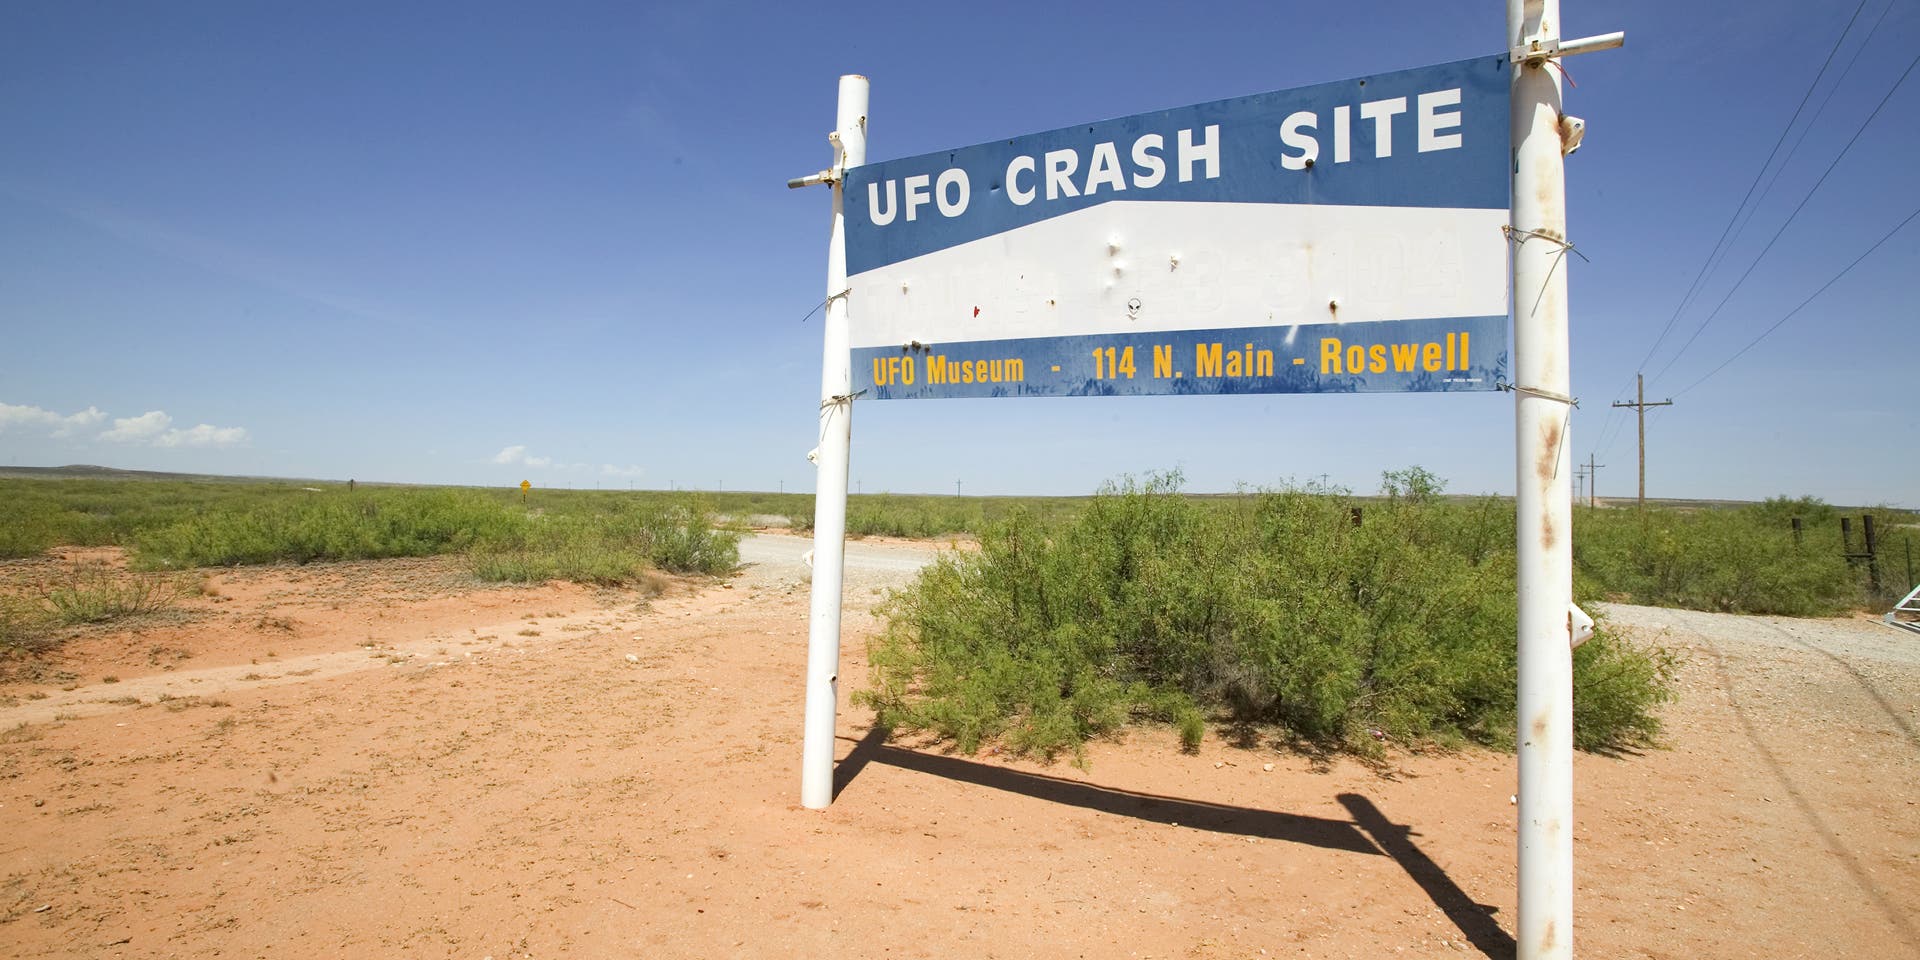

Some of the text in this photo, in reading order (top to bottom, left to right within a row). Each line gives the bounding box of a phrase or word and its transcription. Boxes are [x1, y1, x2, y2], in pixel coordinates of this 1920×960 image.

[868, 87, 1462, 226] UFO CRASH SITE
[873, 356, 915, 386] UFO
[926, 355, 1025, 385] Museum
[1092, 346, 1137, 380] 114
[1153, 345, 1183, 379] N.
[1195, 343, 1274, 378] Main
[1320, 332, 1470, 375] Roswell
